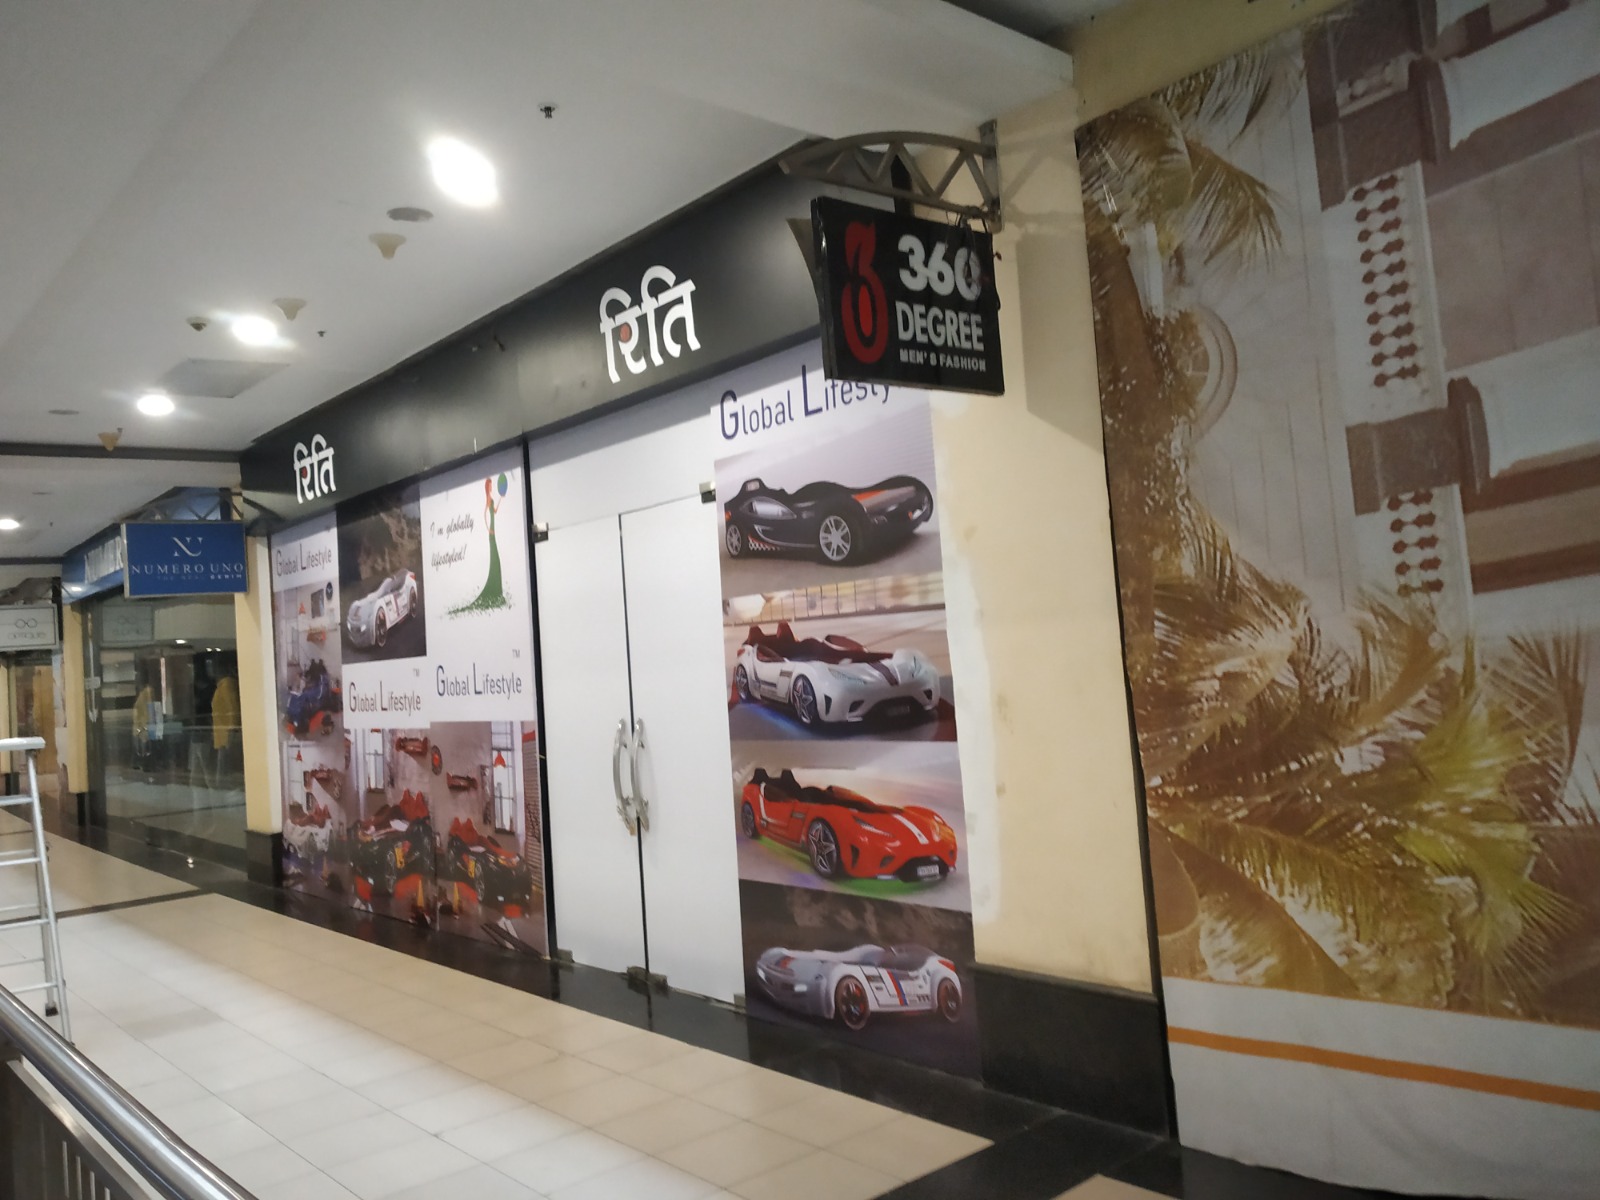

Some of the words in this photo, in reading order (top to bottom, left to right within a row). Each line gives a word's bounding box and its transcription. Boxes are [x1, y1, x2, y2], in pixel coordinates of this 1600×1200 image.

[898, 234, 983, 302] 360
[599, 265, 702, 385] रिति
[895, 300, 985, 352] DEGREE
[938, 352, 987, 372] FASHION
[720, 389, 795, 441] Global
[801, 364, 890, 418] Lifesty
[293, 433, 337, 505] रिति
[446, 513, 475, 540] globally
[131, 563, 205, 575] NUMERO
[209, 562, 244, 574] UNO
[275, 549, 299, 577] Global
[299, 542, 332, 571] Lifestyle
[348, 681, 378, 713] Global
[379, 680, 422, 717] Lifestyle
[435, 664, 471, 697] Global
[472, 662, 522, 701] Lifestyle
